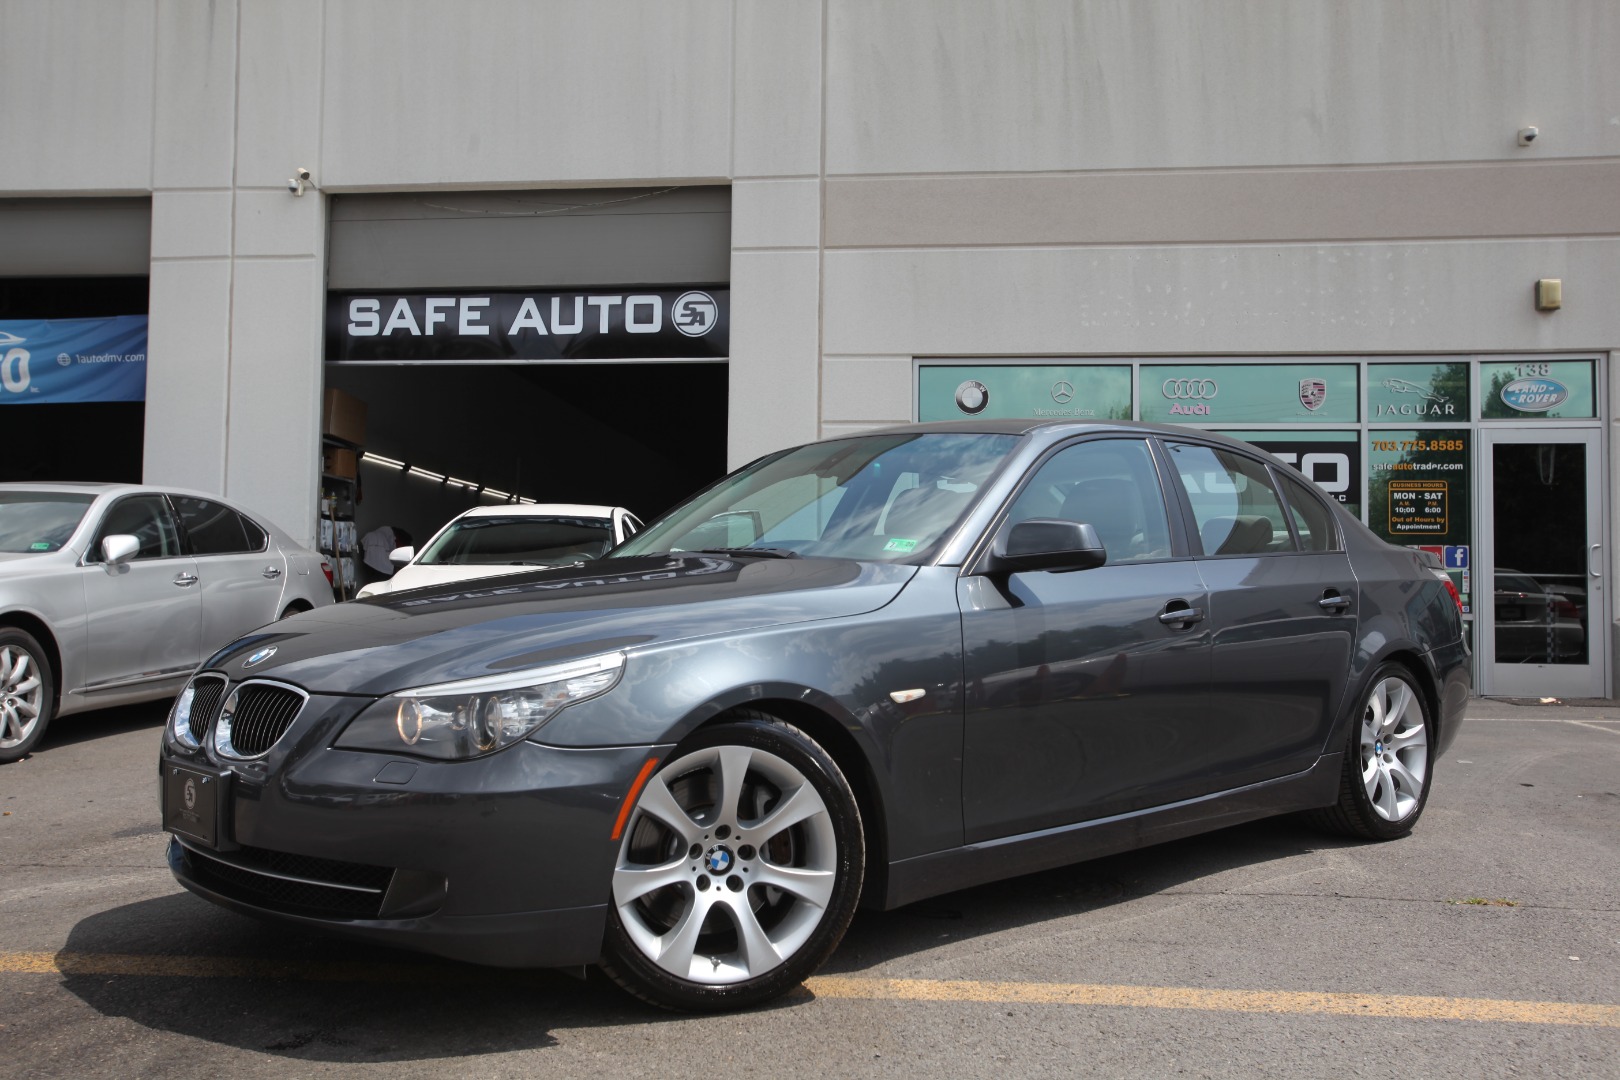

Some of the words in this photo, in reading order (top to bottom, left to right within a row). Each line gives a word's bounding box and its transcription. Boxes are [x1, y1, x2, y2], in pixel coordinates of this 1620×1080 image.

[348, 297, 491, 336] SAFE
[507, 294, 663, 336] AUTO
[75, 353, 146, 364] 1autodmv.com
[0, 347, 31, 393] O
[1514, 363, 1550, 377] 138
[1513, 384, 1548, 394] LAND
[1518, 393, 1558, 403] ROVER
[1169, 403, 1211, 415] Audi
[1376, 404, 1455, 417] JAGUAR
[1372, 440, 1464, 451] 703.775.8585
[1373, 462, 1464, 471] safeautotrader.com
[1393, 492, 1416, 500] MON
[1424, 492, 1443, 500] SAT
